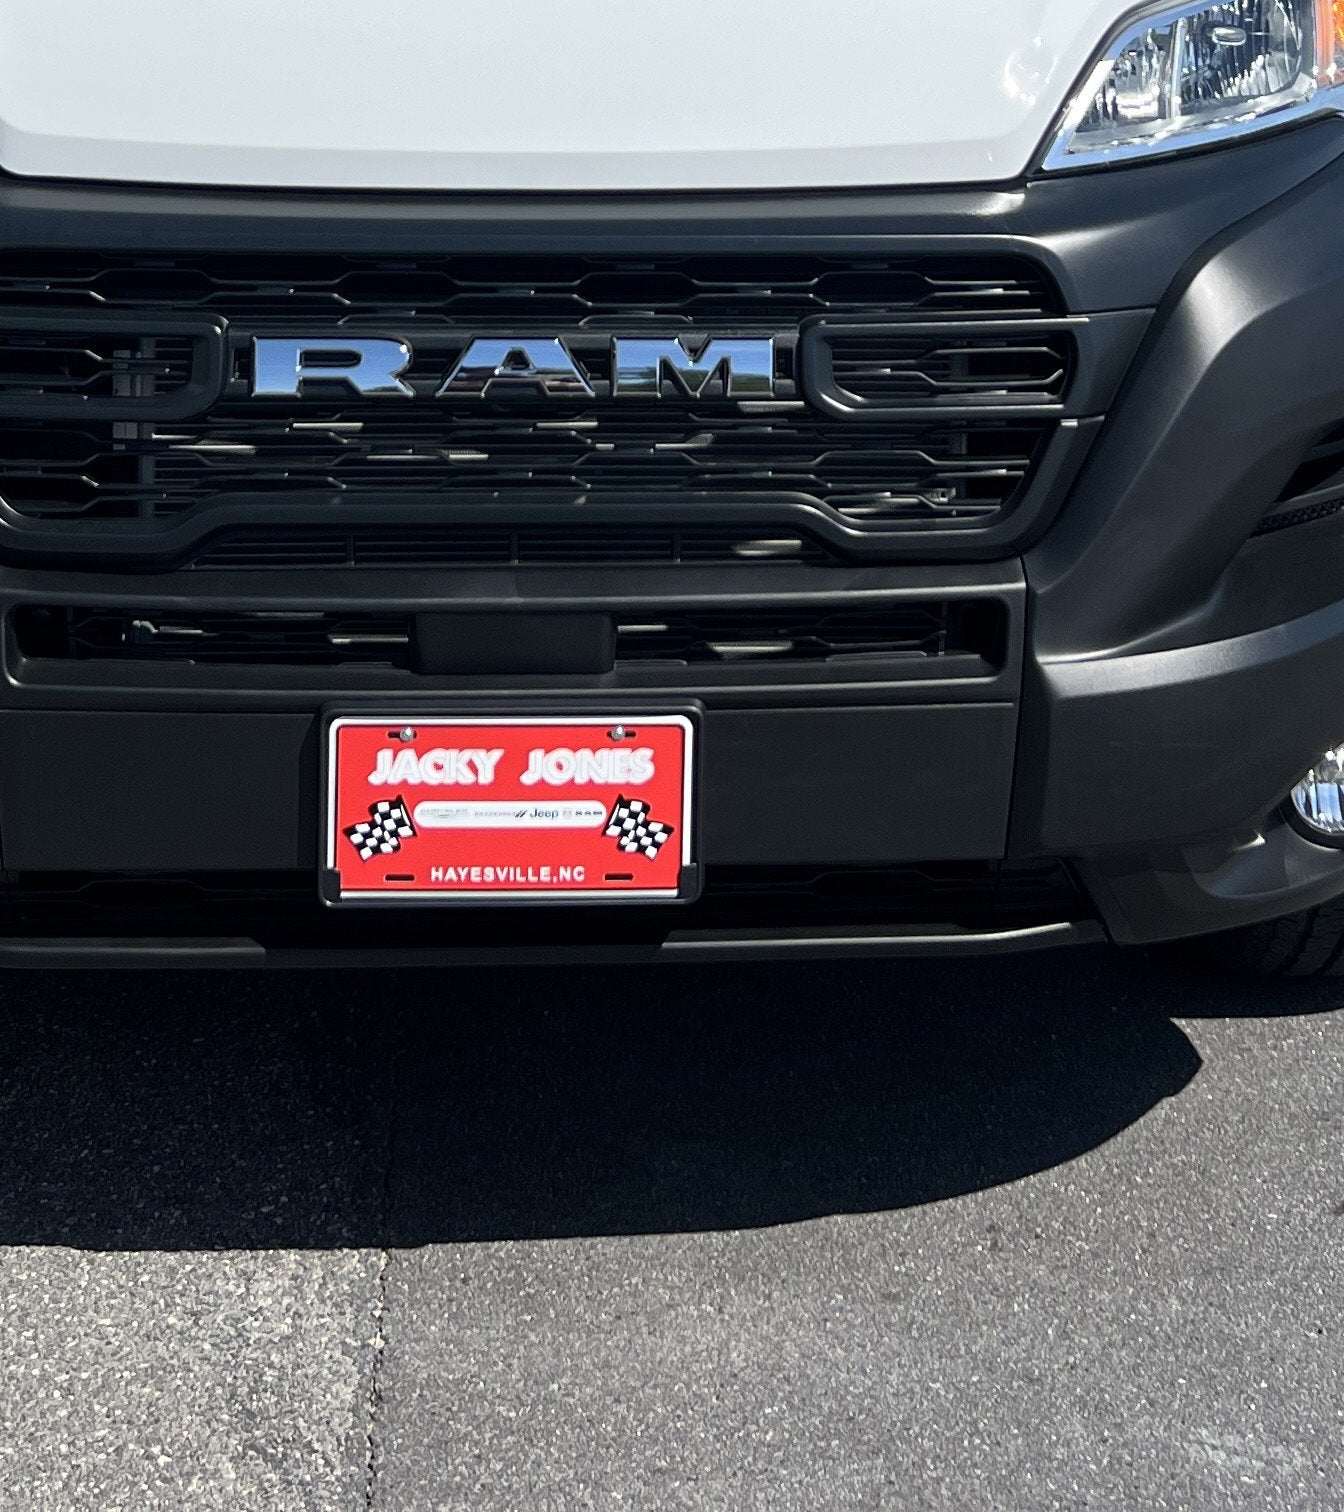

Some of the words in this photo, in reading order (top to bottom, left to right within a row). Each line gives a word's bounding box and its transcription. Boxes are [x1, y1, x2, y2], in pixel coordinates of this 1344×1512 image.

[250, 335, 775, 399] RAM
[367, 747, 505, 786] JACKY
[519, 747, 655, 786] JONES
[529, 807, 559, 821] Jeep
